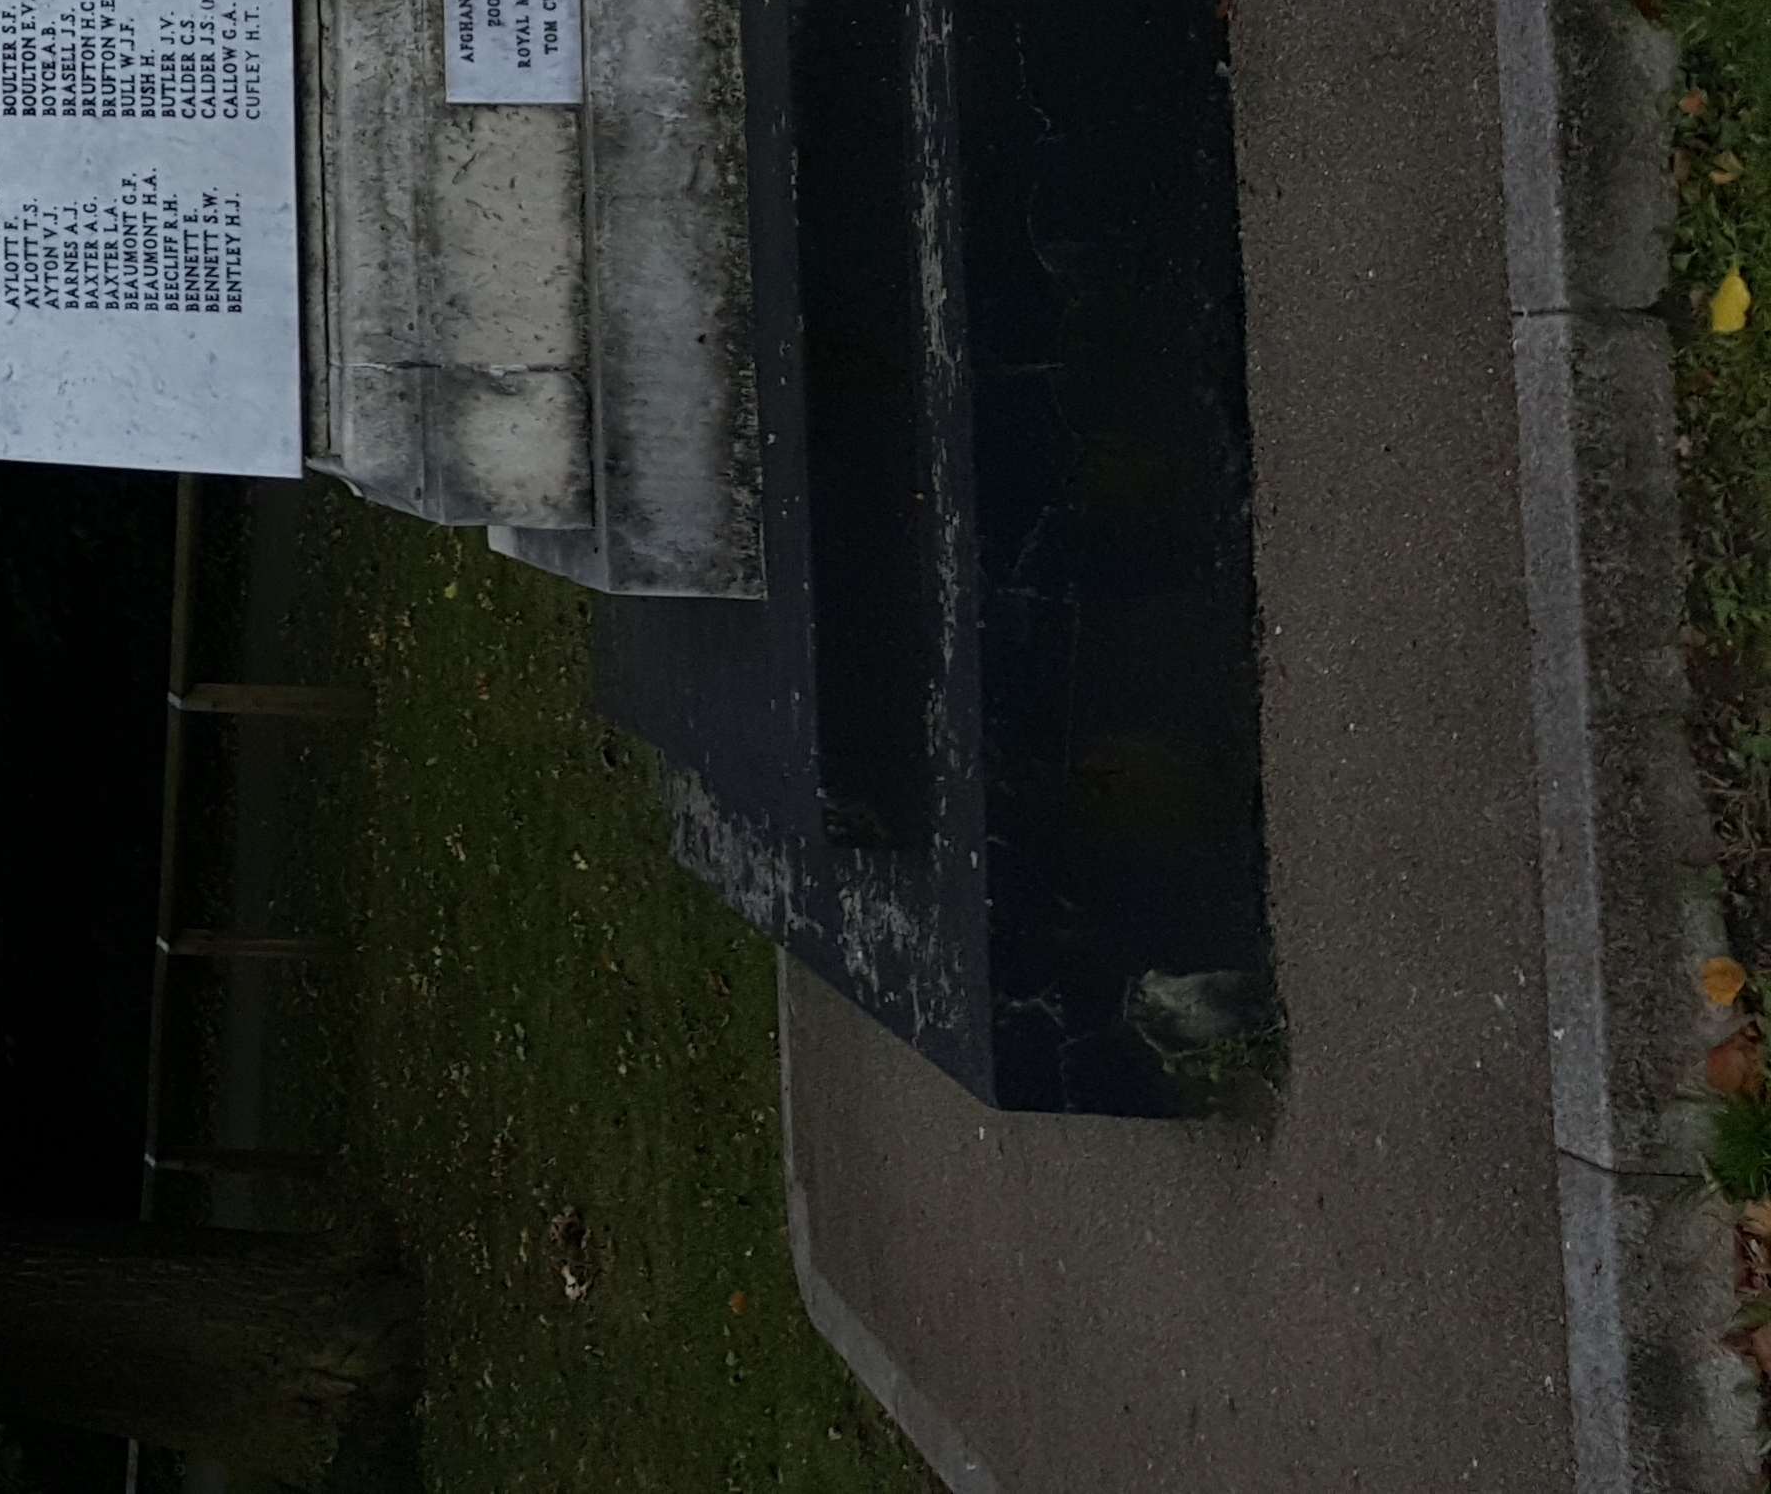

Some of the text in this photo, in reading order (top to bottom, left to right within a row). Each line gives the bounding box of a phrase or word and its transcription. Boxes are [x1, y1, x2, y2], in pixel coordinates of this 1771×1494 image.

[2, 6, 17, 116] BOULTER S.F.
[22, 37, 36, 116] BOULTON
[41, 21, 56, 116] BOYCE A.B.
[61, 43, 76, 117] BRASELL
[140, 49, 155, 118] BUSH H.
[160, 11, 176, 118] BUTLER J.V.
[181, 52, 196, 119] CALDER
[201, 52, 216, 119] CALDER
[223, 46, 238, 119] CALLOW
[244, 7, 260, 120] CUFLEY H.T.
[516, 16, 531, 68] ROYAL
[543, 21, 558, 55] TOM
[121, 75, 135, 117] BULL
[4, 216, 20, 310] AYLOTT F.
[23, 198, 40, 309] AYLOTT T.S.
[43, 207, 59, 310] AYTON V.J.
[63, 201, 79, 309] BARNES A.J.
[83, 197, 99, 309] BAXTER A.G.
[103, 199, 119, 310] BAXTER L.A.
[122, 173, 139, 311] BEAUMONT G.F.
[142, 168, 159, 311] BEAUMONT H.A.
[163, 194, 179, 311] BEECLIFF R.H.
[183, 209, 200, 312] BENNETT E.
[202, 187, 219, 313] BENNETT S.W.
[225, 193, 242, 313] BENTLEY H.J.
